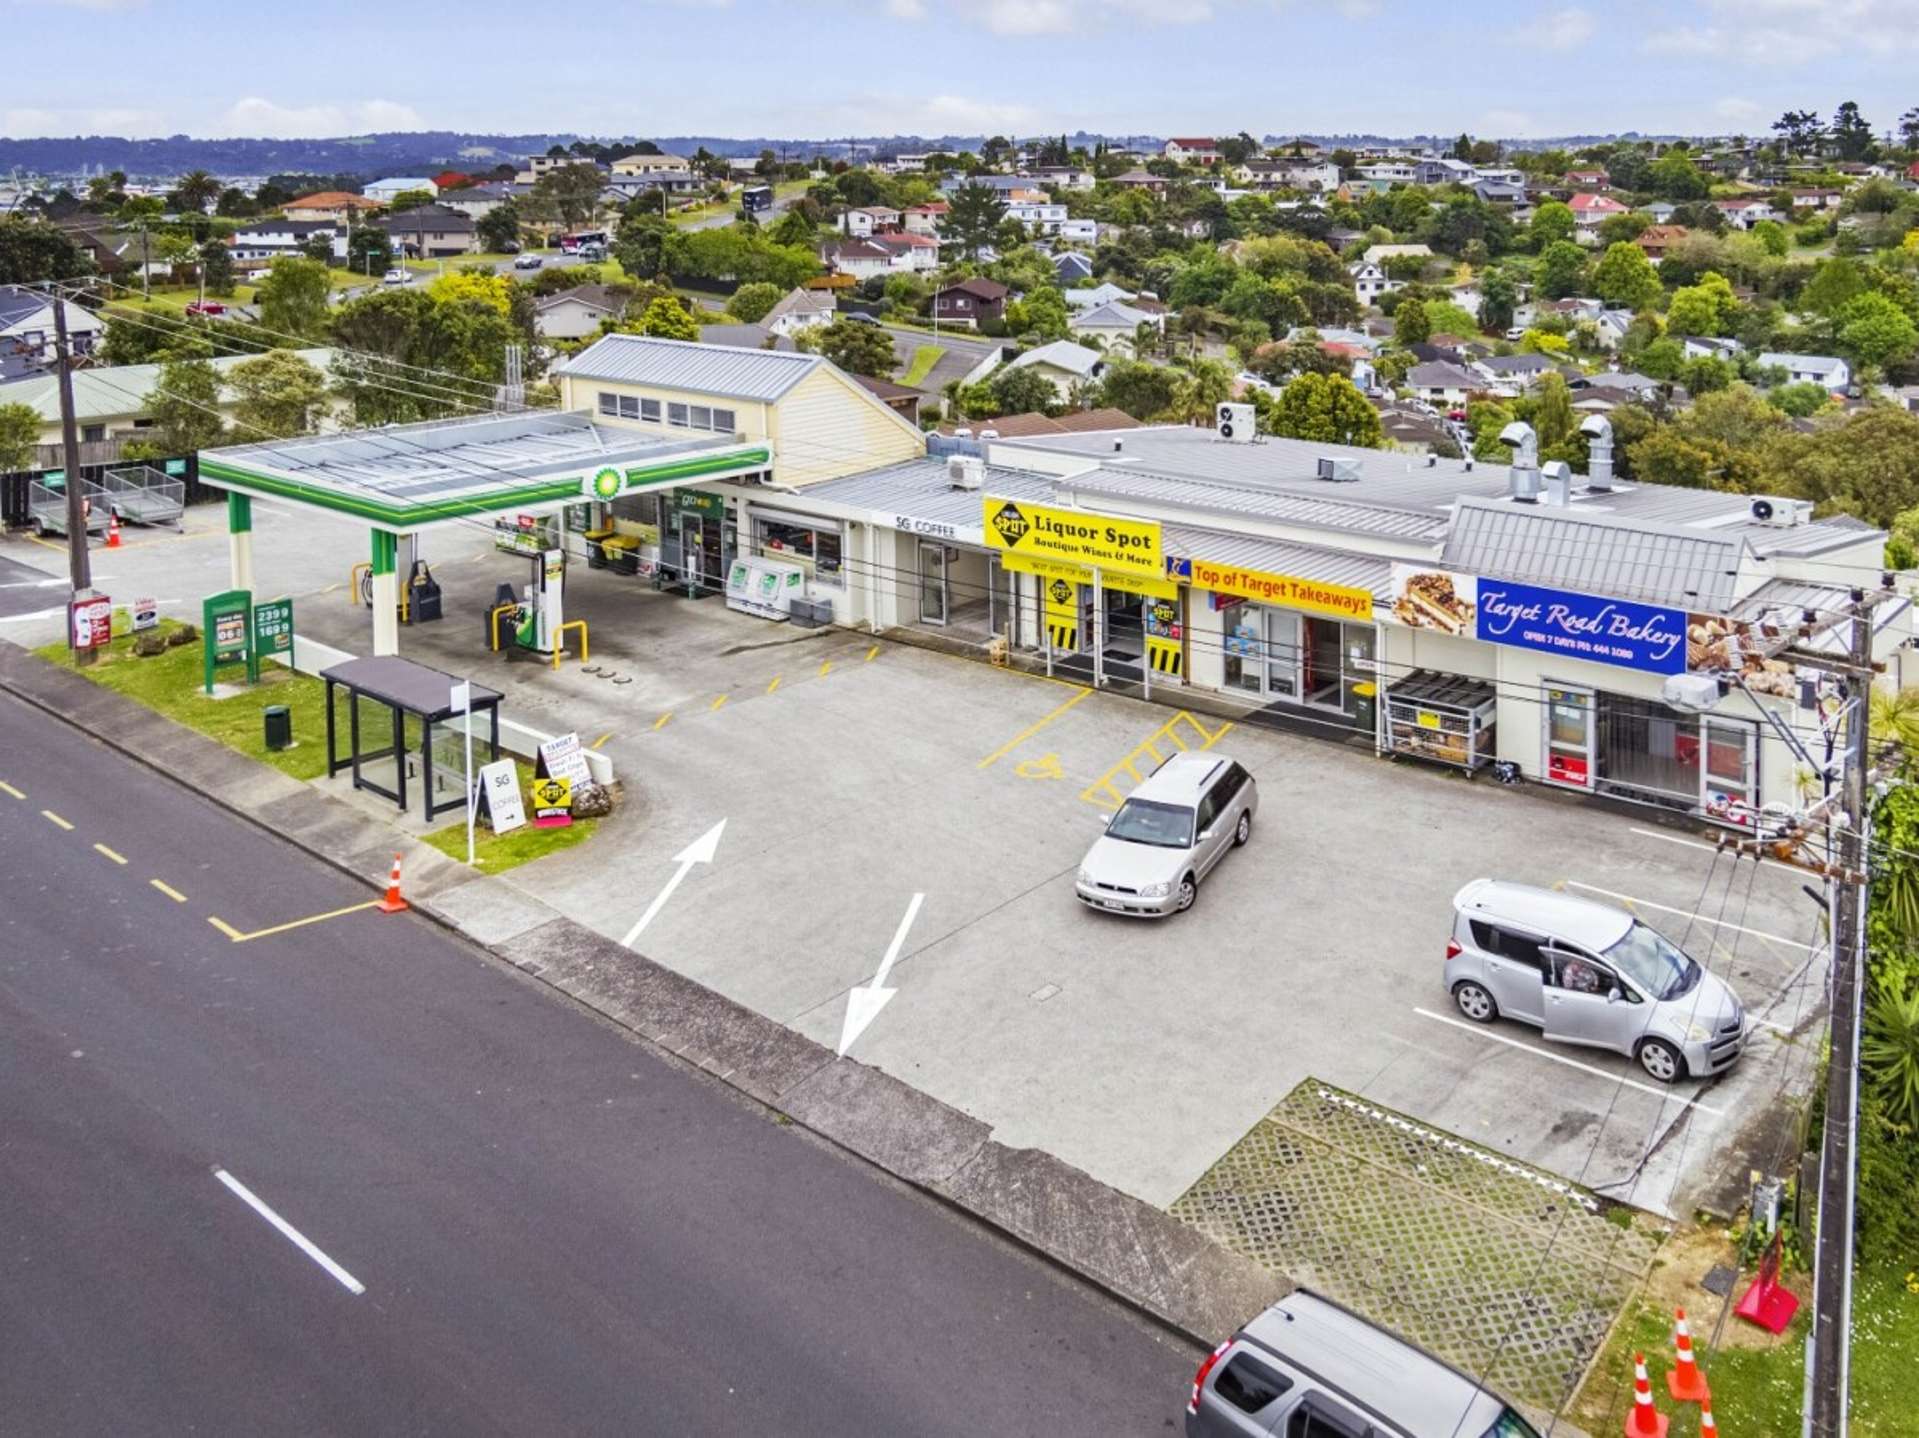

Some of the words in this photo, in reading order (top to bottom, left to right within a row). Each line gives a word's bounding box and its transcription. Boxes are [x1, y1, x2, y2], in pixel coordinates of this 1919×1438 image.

[896, 516, 911, 530] SG
[915, 520, 956, 537] COFFEE
[1034, 515, 1099, 541] Liquor
[1105, 527, 1152, 550] Spot
[1034, 537, 1079, 554] Boutique
[1082, 544, 1112, 560] Wines
[1114, 552, 1123, 561] &
[1126, 554, 1152, 567] More
[1195, 565, 1219, 587] Top
[1223, 572, 1236, 586] of
[1240, 574, 1286, 598] Target
[1290, 583, 1367, 614] Takeaways
[1480, 592, 1542, 635] Target
[1546, 604, 1617, 634] Road
[1608, 614, 1682, 661] Bakery
[1523, 631, 1546, 644] OPEN
[1547, 635, 1554, 644] 7
[495, 774, 510, 788] SG
